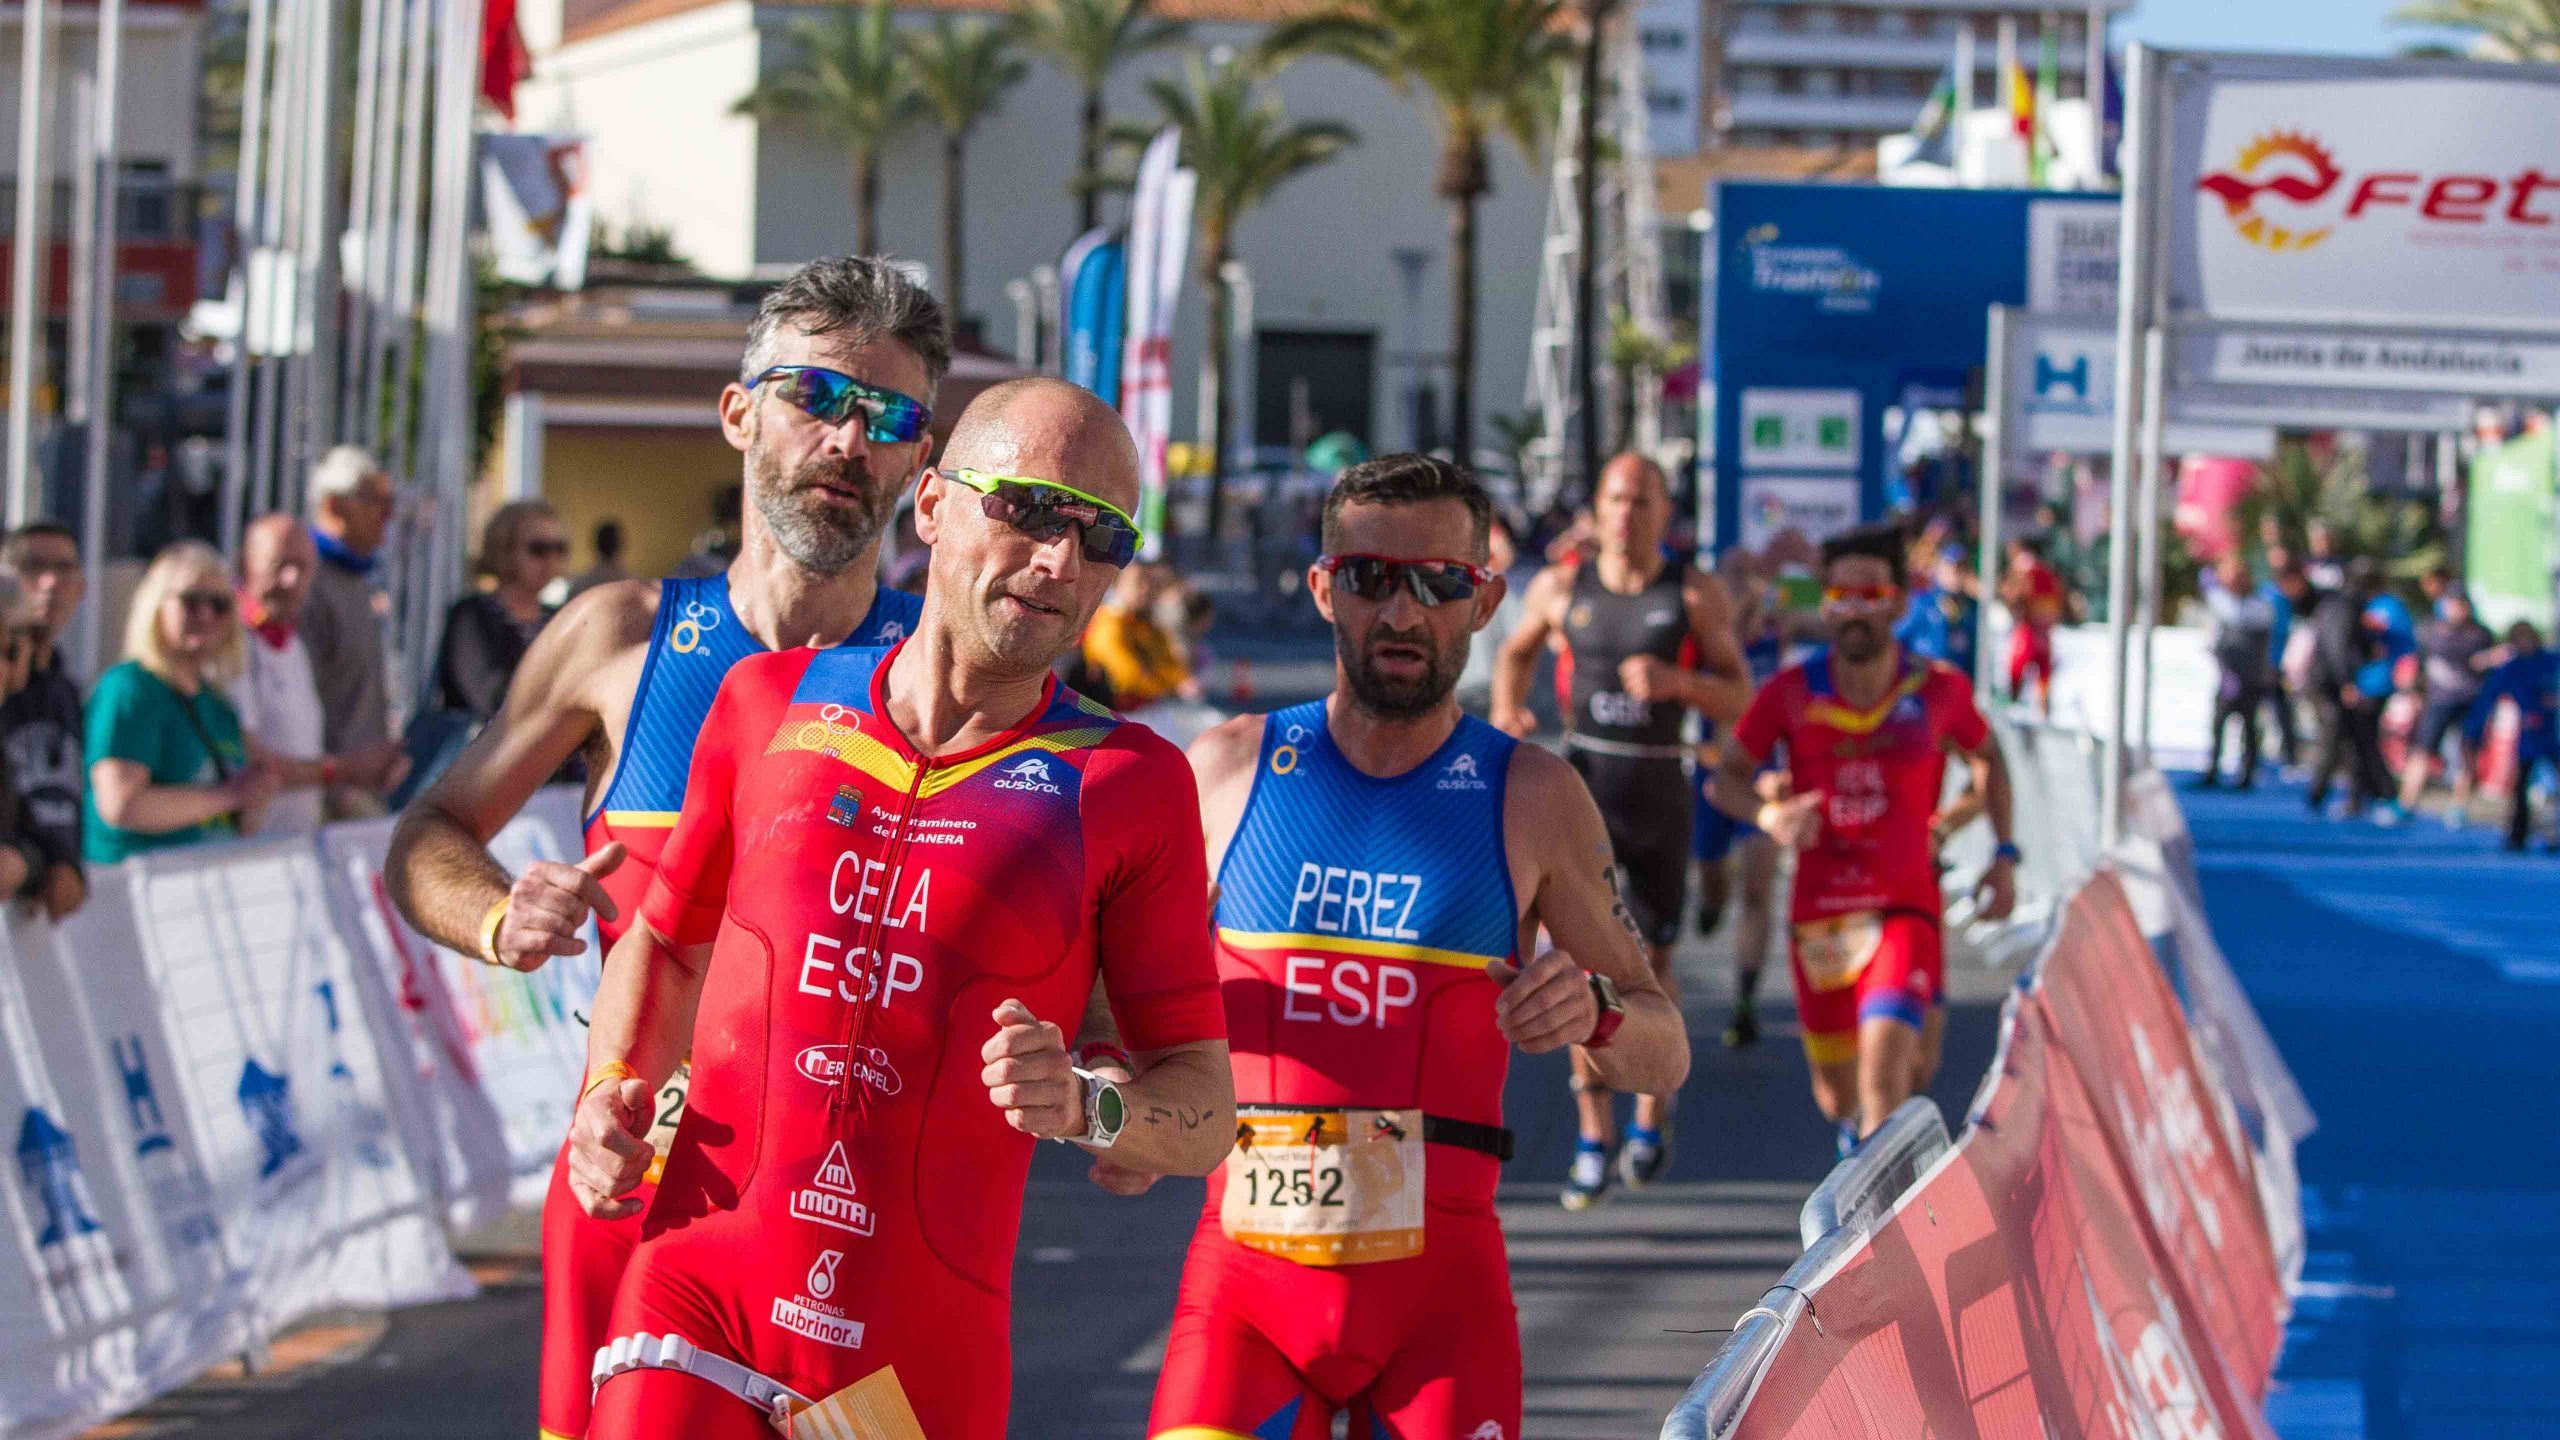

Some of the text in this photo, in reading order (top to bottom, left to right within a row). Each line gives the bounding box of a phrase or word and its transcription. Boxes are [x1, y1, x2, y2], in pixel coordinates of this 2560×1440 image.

[872, 825, 889, 837] de
[829, 850, 931, 933] CELA
[1288, 861, 1422, 940] PEREZ
[798, 932, 924, 1009] ESP
[1283, 955, 1418, 1029] ESP
[799, 1189, 867, 1226] MOTA
[1245, 1167, 1345, 1208] 1252
[775, 1302, 852, 1344] Lubrinor
[794, 1294, 847, 1318] PETRONAS
